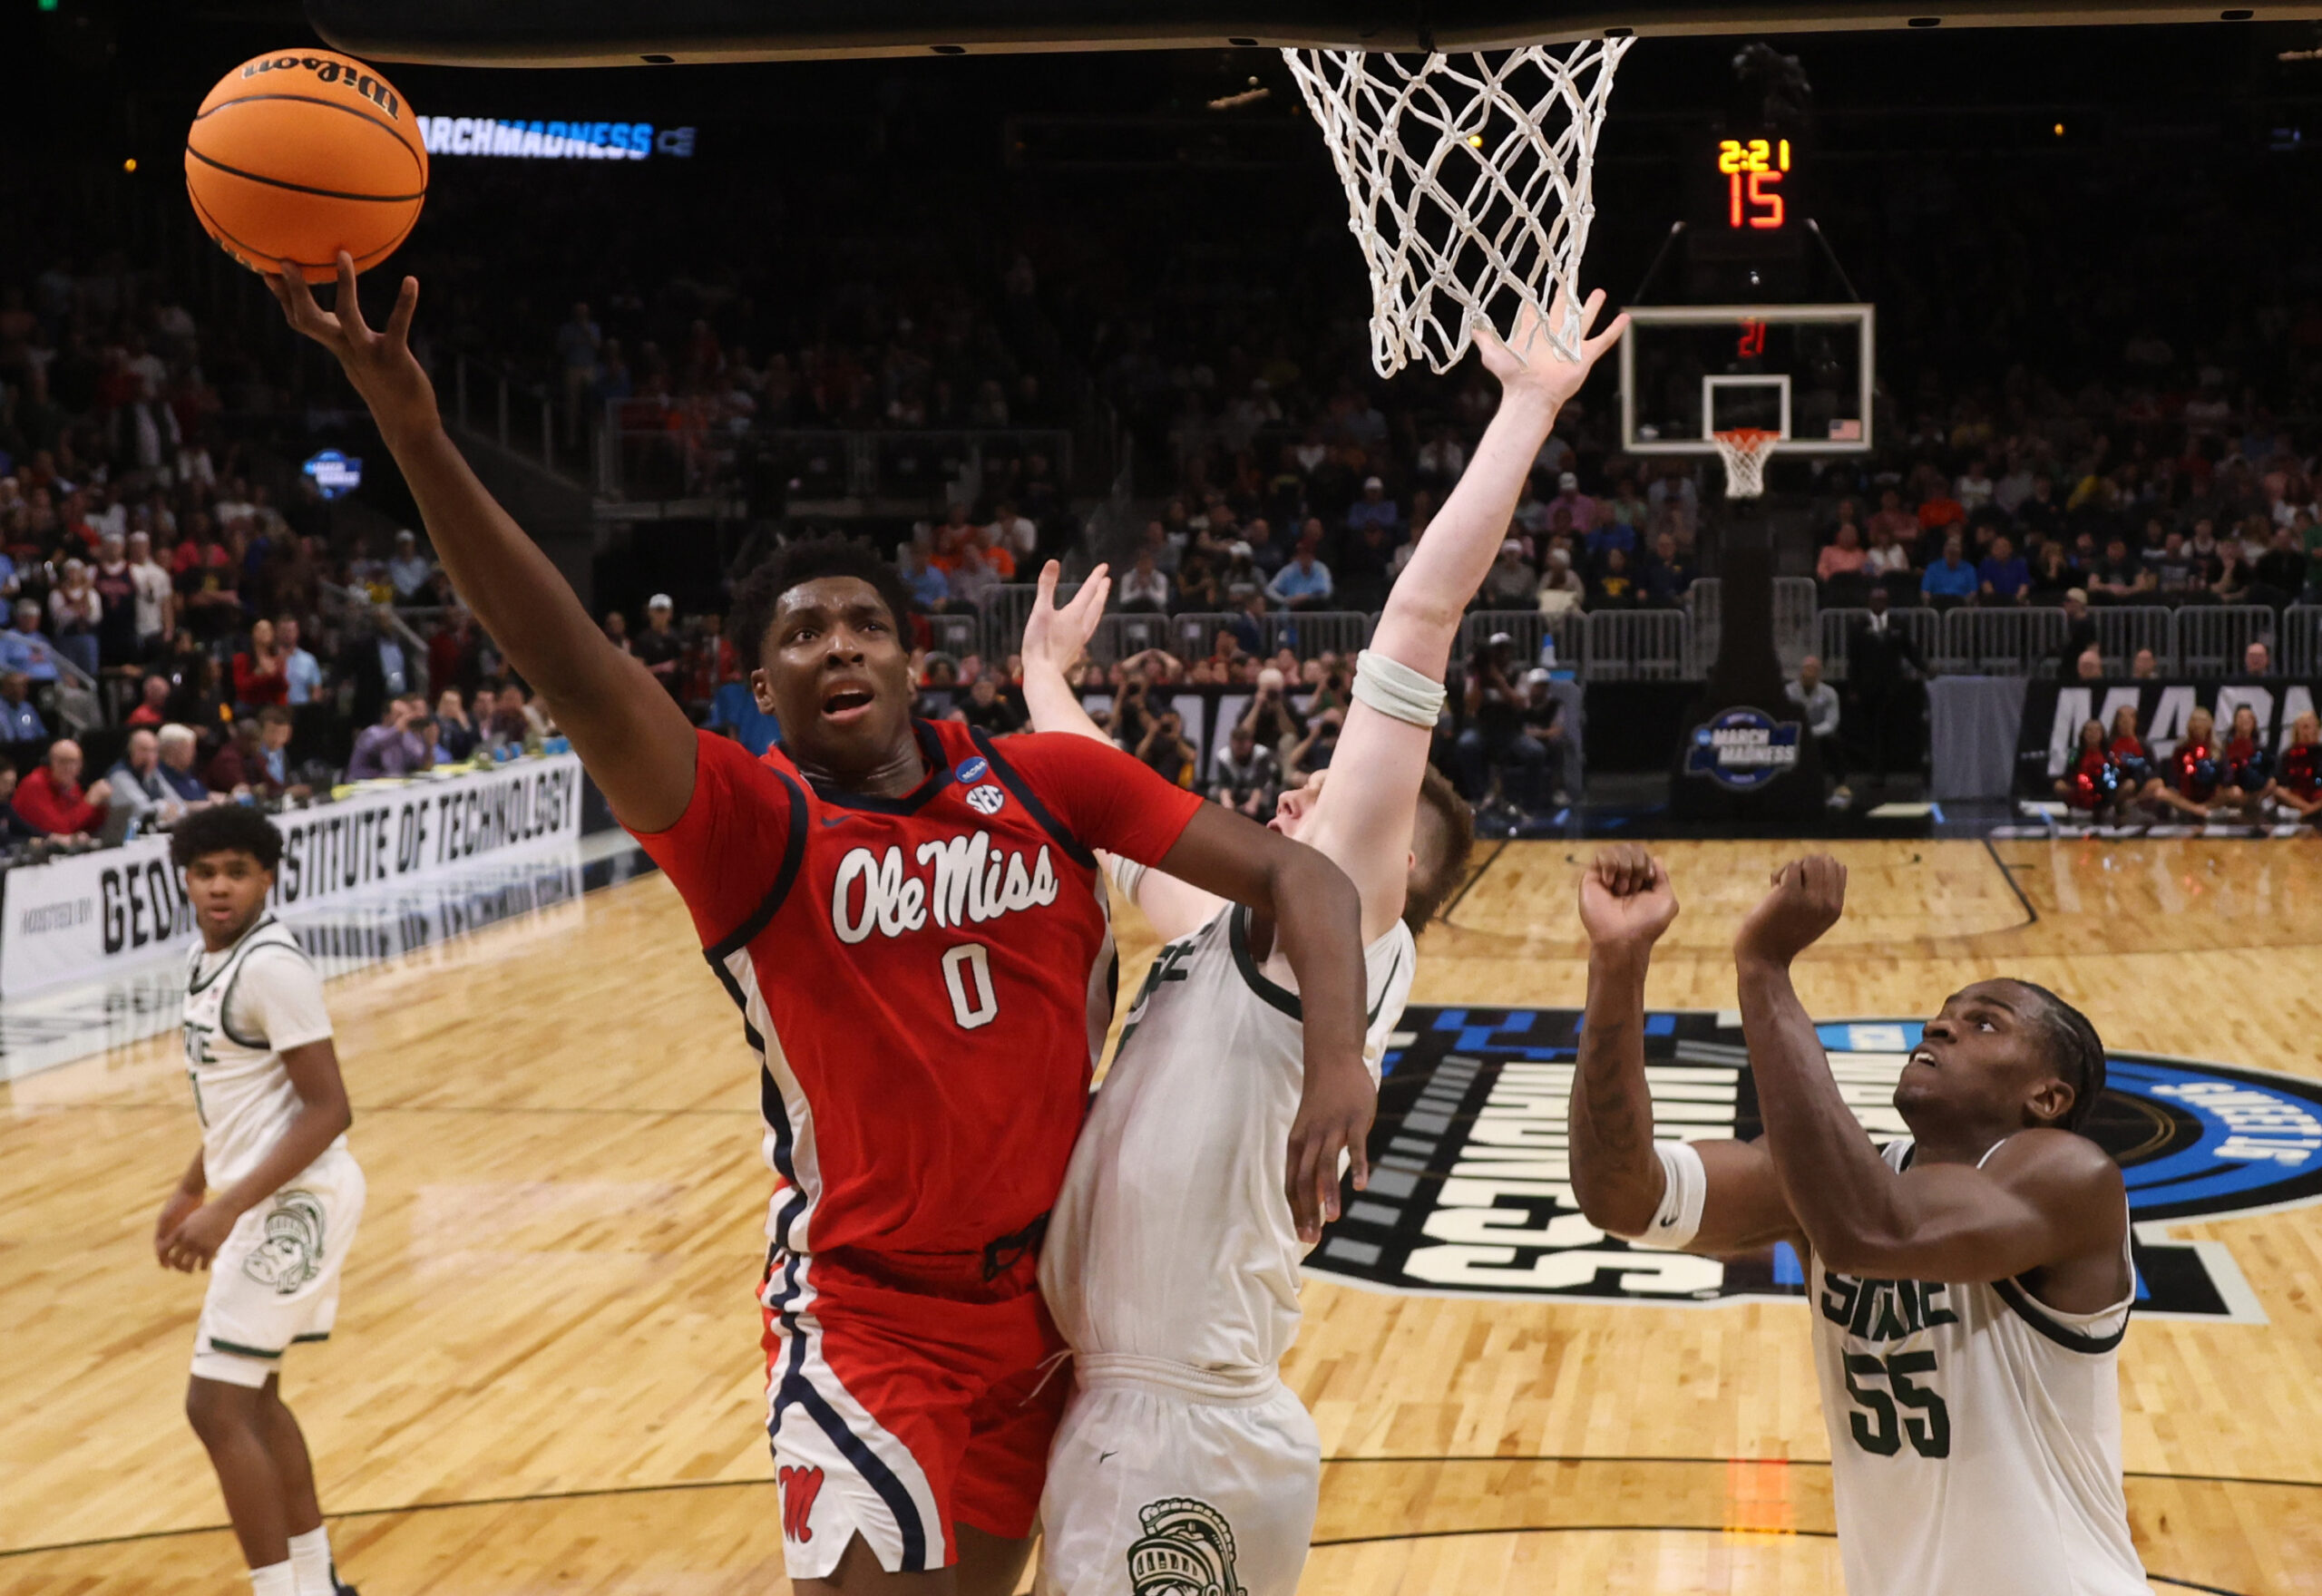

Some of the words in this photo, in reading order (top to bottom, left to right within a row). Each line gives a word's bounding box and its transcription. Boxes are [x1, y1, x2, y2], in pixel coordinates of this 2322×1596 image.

[241, 56, 399, 121] Wilson
[1719, 139, 1790, 173] 2:21
[1730, 170, 1784, 229] 15
[1712, 728, 1770, 746] MARCH
[1719, 744, 1795, 764] MADNESS
[398, 798, 430, 873] OF
[437, 767, 576, 862] TECHNOLOGY
[966, 784, 1004, 814] SEC
[832, 844, 928, 944] Ole
[915, 829, 1059, 929] Miss
[941, 941, 999, 1030] 0
[1841, 1346, 1951, 1458] 55
